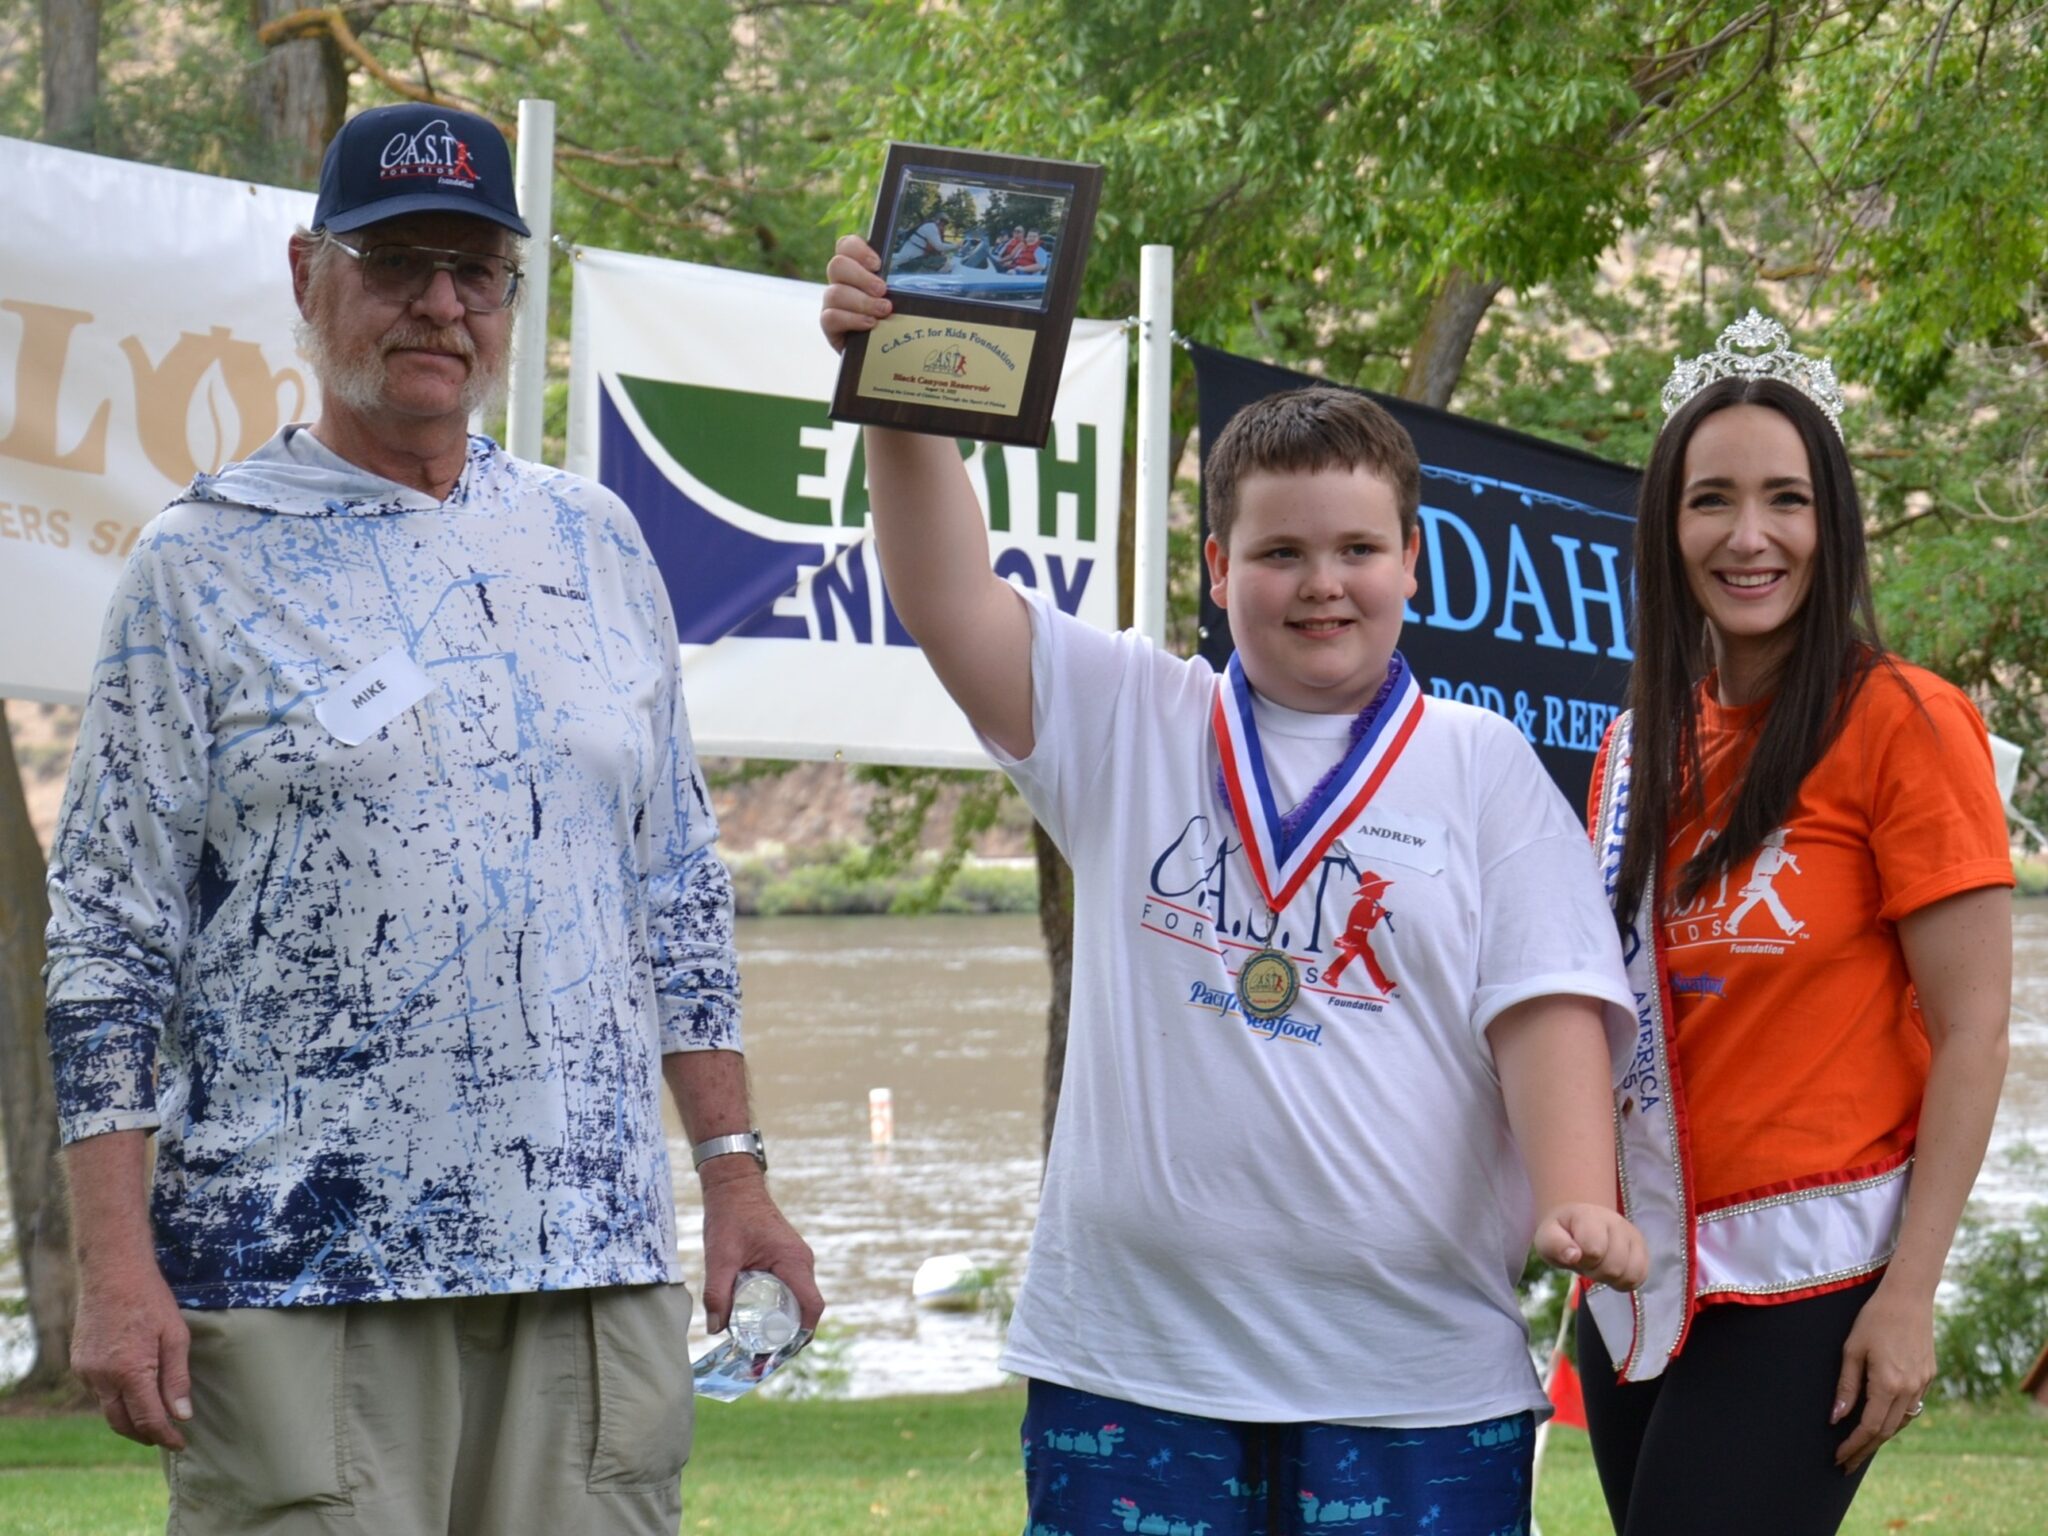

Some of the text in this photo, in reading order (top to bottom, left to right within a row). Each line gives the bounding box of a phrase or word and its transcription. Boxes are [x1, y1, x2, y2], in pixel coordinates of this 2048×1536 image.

[928, 328, 942, 337] for
[945, 327, 967, 339] Kids
[969, 332, 1016, 371] Foundation
[893, 373, 916, 383] Black
[917, 376, 948, 387] Canyon
[950, 380, 991, 393] Reservoir
[1403, 504, 1637, 662] DAH
[352, 679, 388, 709] MIKE
[1513, 690, 1538, 743] &
[1357, 825, 1426, 848] ANDREW
[1142, 903, 1204, 940] FOR
[1730, 943, 1785, 955] Foundation
[1328, 995, 1384, 1014] Foundation
[1633, 992, 1660, 1113] AMERICA
